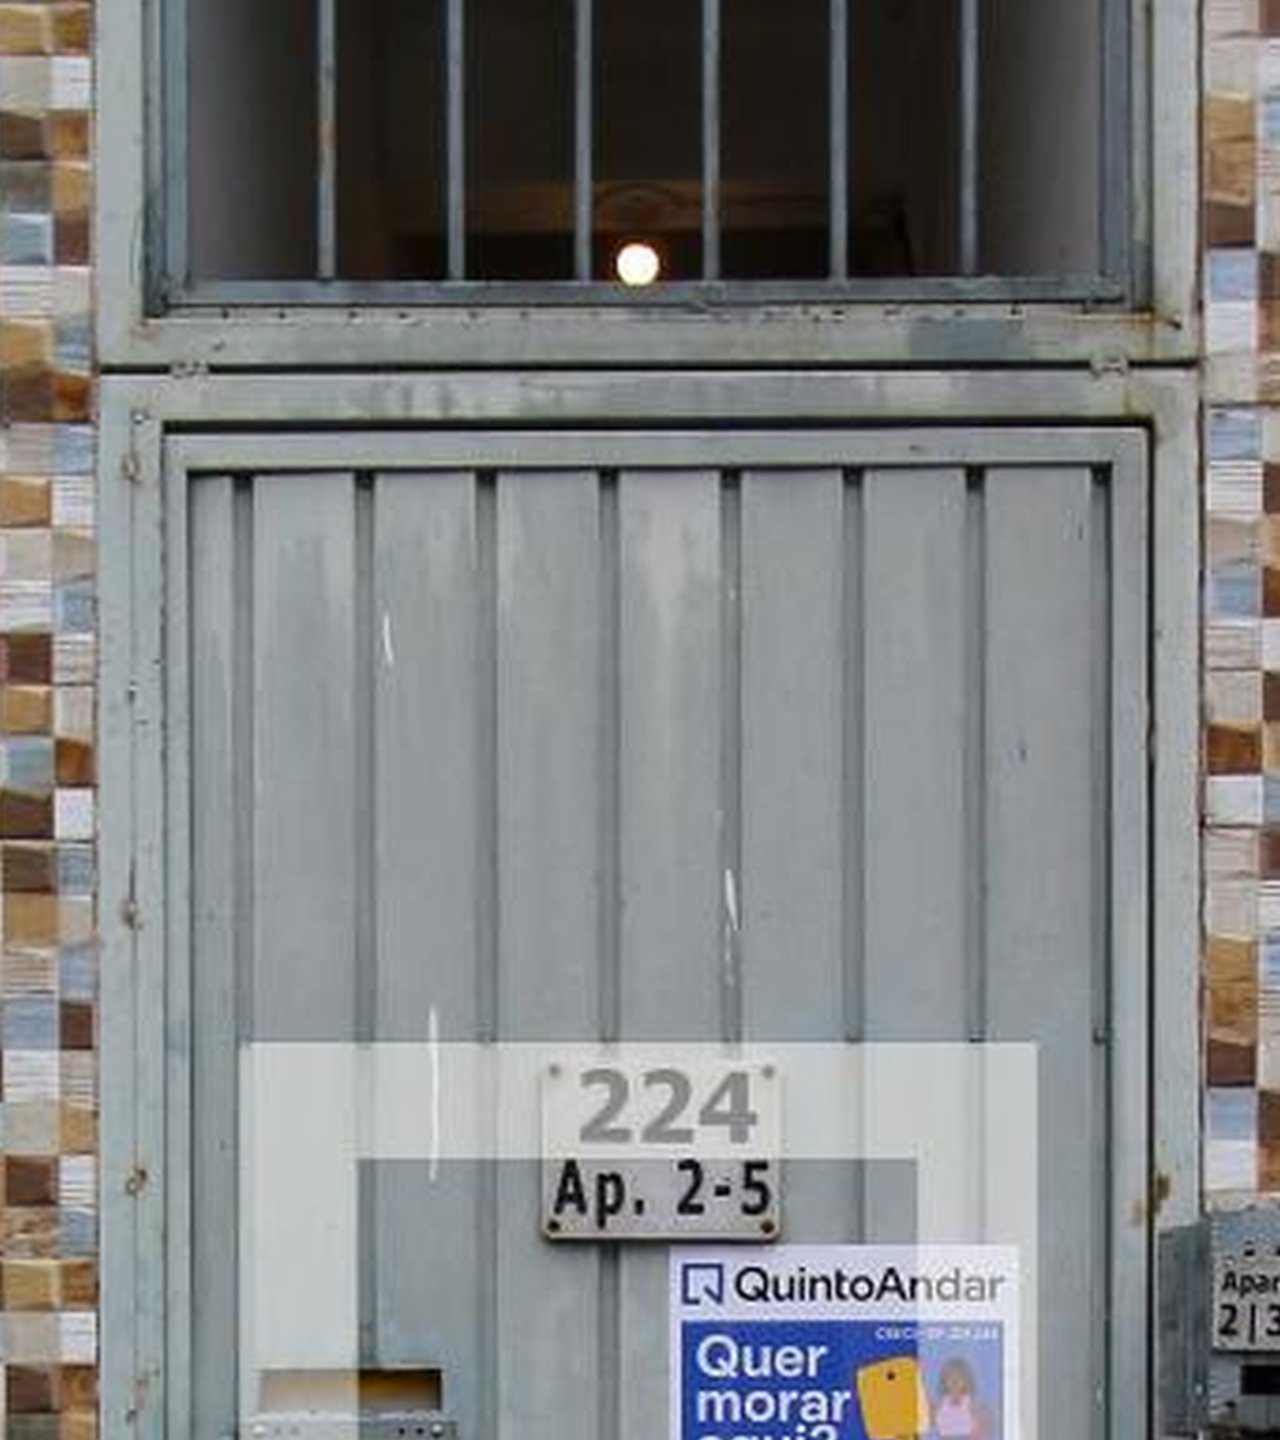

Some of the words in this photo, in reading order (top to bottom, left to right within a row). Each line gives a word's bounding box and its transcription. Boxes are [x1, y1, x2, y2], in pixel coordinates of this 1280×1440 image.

[579, 1068, 758, 1144] 224
[553, 1158, 645, 1229] Ap.
[676, 1158, 770, 1215] 2-5
[734, 1266, 1005, 1302] QuintoAndar
[696, 1334, 827, 1378] Quer
[697, 1387, 851, 1422] morar
